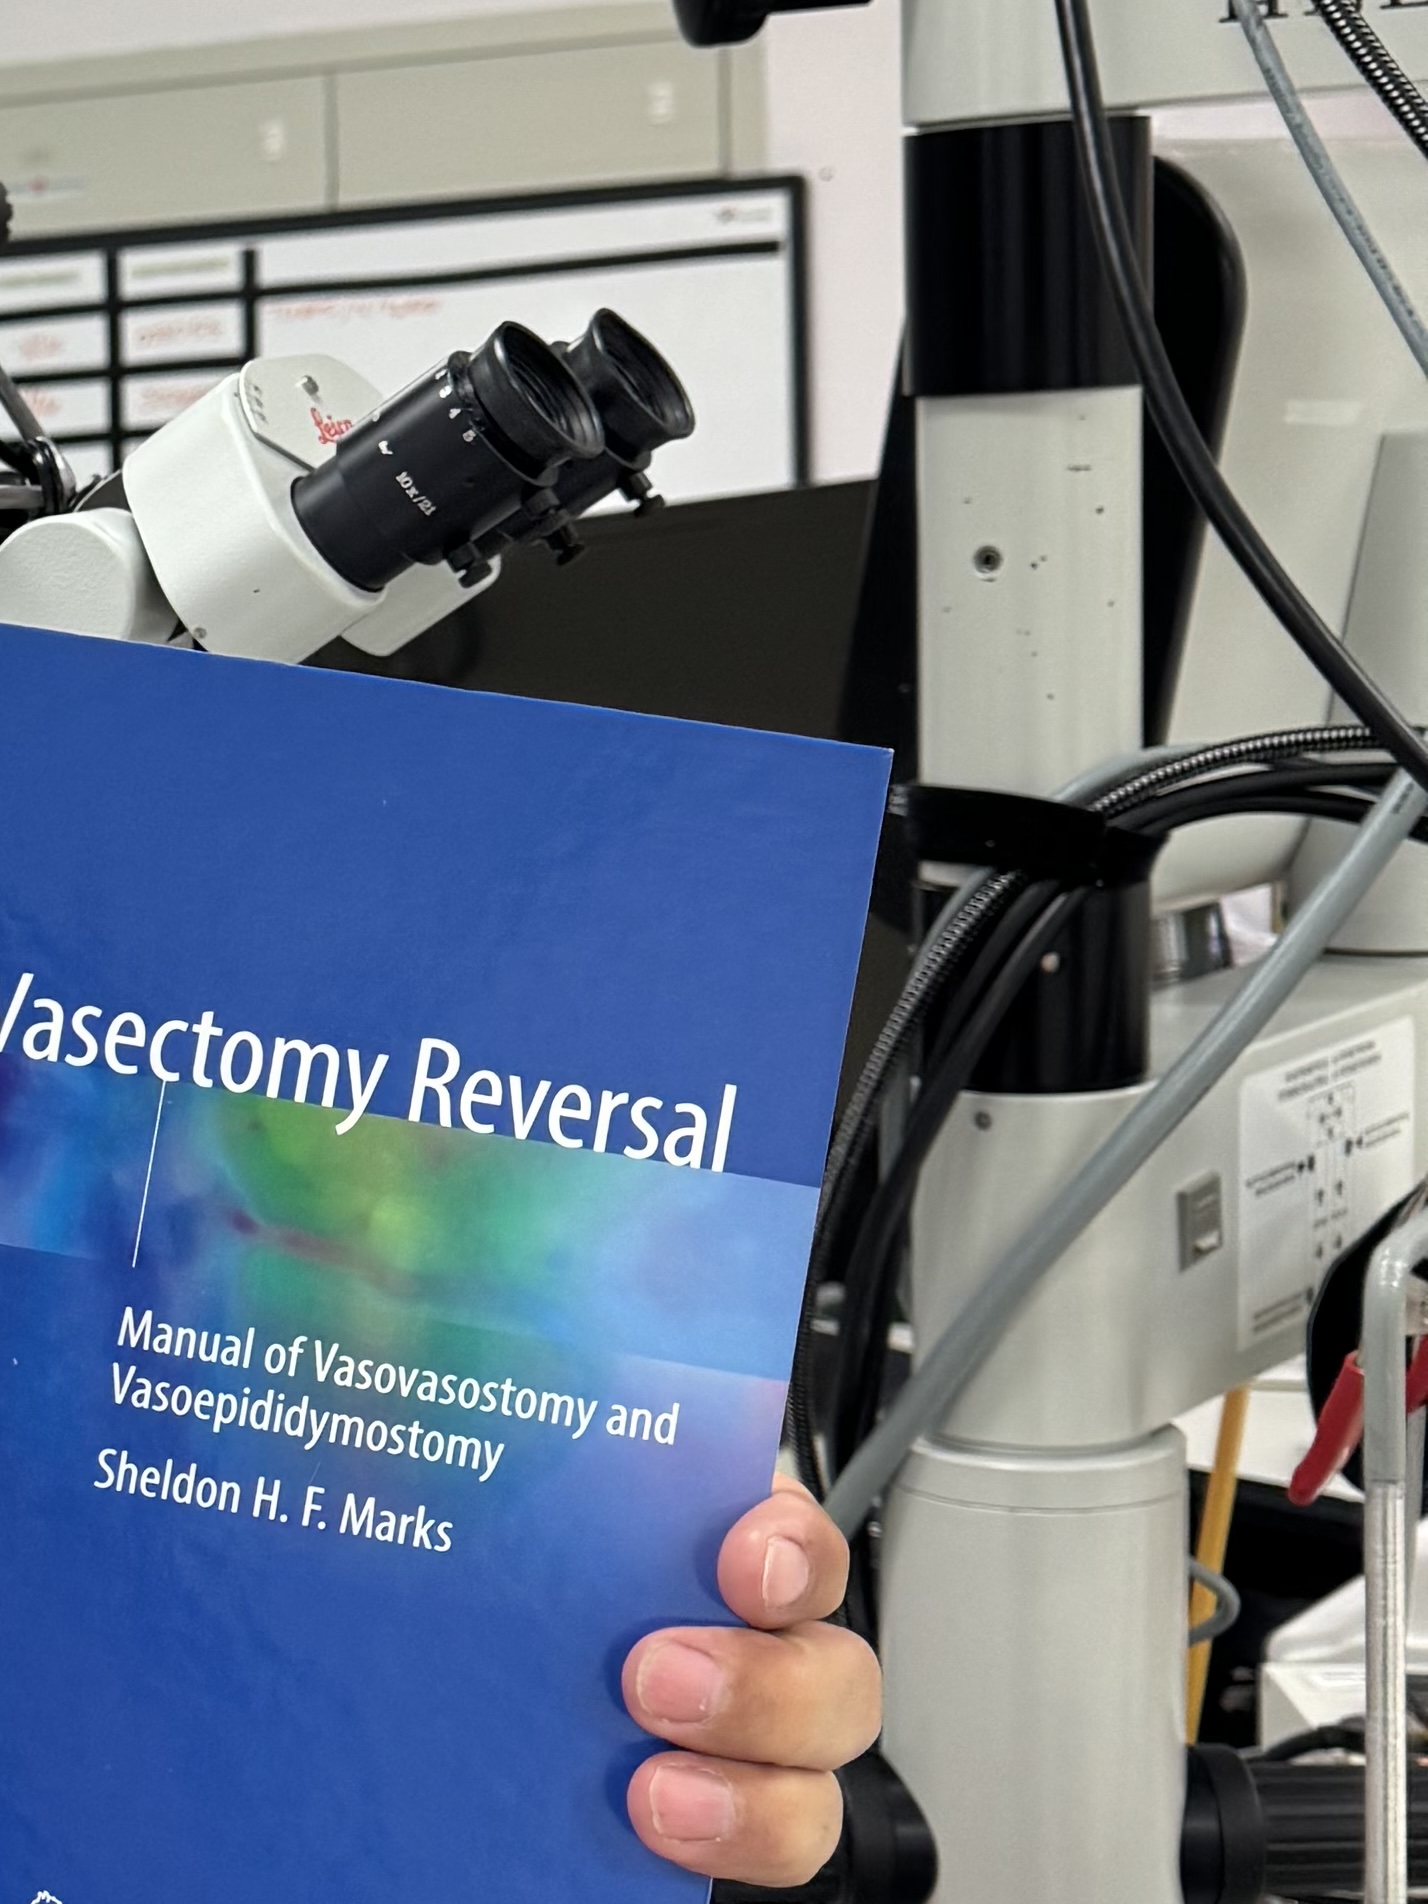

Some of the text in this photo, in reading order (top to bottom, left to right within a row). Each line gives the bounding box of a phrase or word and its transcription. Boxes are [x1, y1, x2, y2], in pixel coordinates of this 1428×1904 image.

[408, 1037, 738, 1174] Reversal
[112, 1363, 505, 1483] Vasoepididymostomy
[117, 1306, 680, 1447] Manual of Vasovasostomy and
[94, 1447, 453, 1552] Sheldon H. F. Marks
